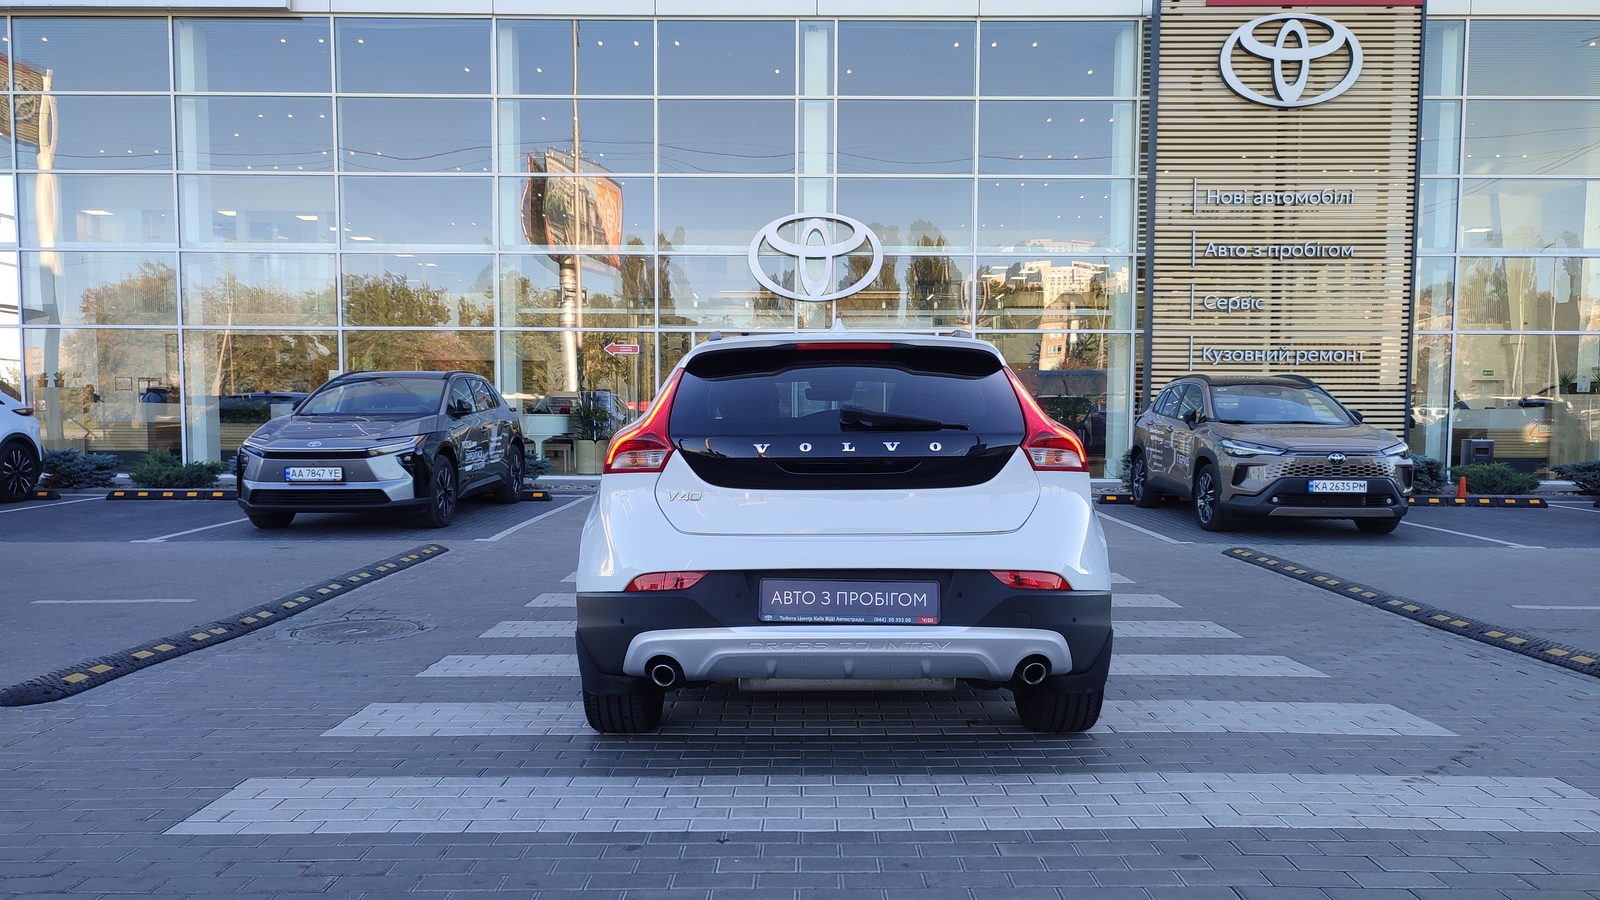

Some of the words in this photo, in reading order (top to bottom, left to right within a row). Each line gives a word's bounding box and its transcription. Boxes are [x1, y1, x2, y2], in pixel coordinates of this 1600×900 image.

[1205, 189, 1248, 205] Нові
[1252, 188, 1356, 205] автомобілі
[1203, 241, 1247, 257] Авто
[1252, 245, 1262, 257] з
[1267, 241, 1355, 261] пробігом
[1202, 294, 1265, 313] Сервіс
[1201, 346, 1290, 365] Кузовний
[1295, 349, 1366, 365] ремонт
[753, 441, 942, 453] VOLVO
[291, 469, 304, 478] AA
[305, 469, 326, 478] 7847
[1314, 482, 1328, 491] KA
[1329, 482, 1351, 491] 2635
[1352, 482, 1366, 491] PM
[667, 491, 702, 501] V40
[771, 591, 816, 605] АВТО
[836, 591, 927, 607] ПРОБІГОМ
[748, 641, 829, 651] CROSS
[836, 641, 951, 651] COUNTRY
